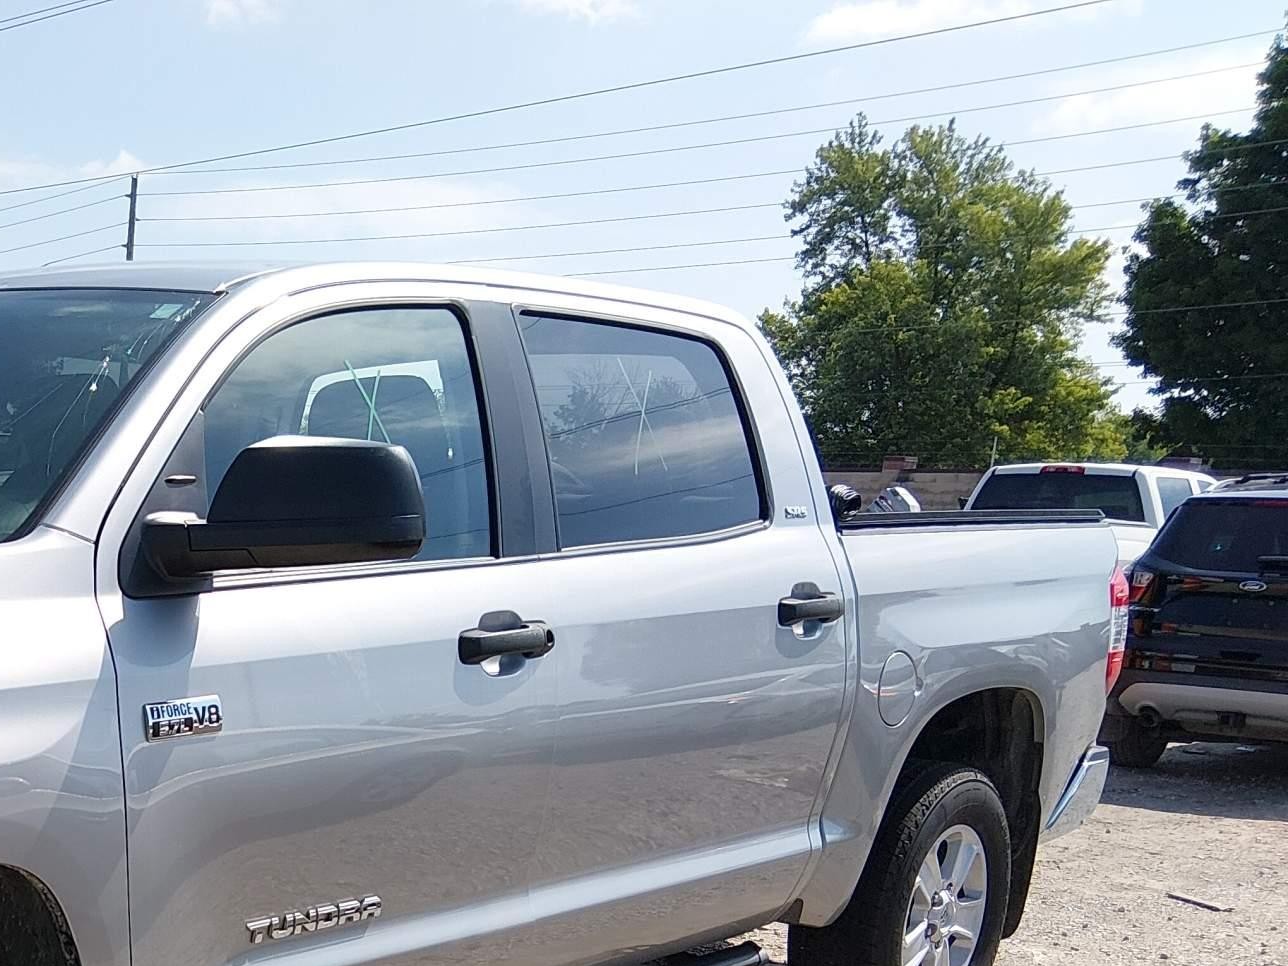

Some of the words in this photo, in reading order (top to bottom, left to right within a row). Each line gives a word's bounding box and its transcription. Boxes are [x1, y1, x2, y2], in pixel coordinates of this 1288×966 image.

[193, 704, 223, 727] V8
[159, 718, 191, 737] 5.7L
[245, 894, 382, 945] TUNDRA
